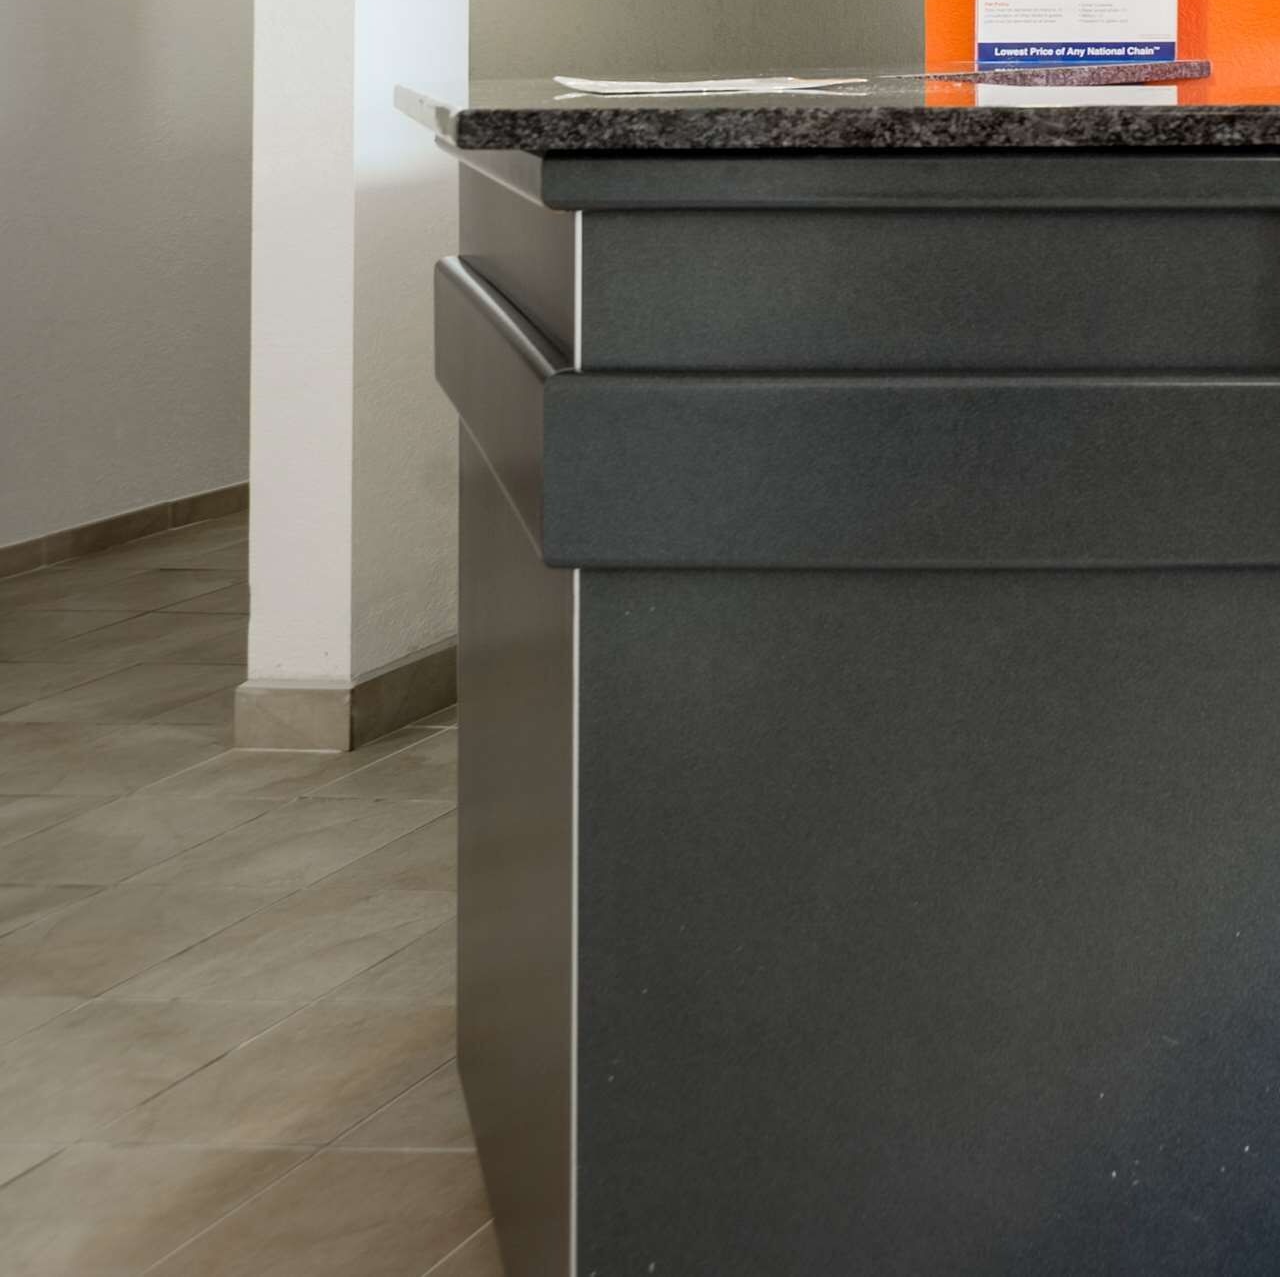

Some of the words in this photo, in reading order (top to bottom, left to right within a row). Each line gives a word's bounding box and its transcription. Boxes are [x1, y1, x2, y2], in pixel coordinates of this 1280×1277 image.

[994, 47, 1028, 57] Lowest
[1030, 47, 1053, 57] Price
[1055, 46, 1065, 57] of
[1067, 46, 1085, 58] Any
[1087, 46, 1126, 56] National
